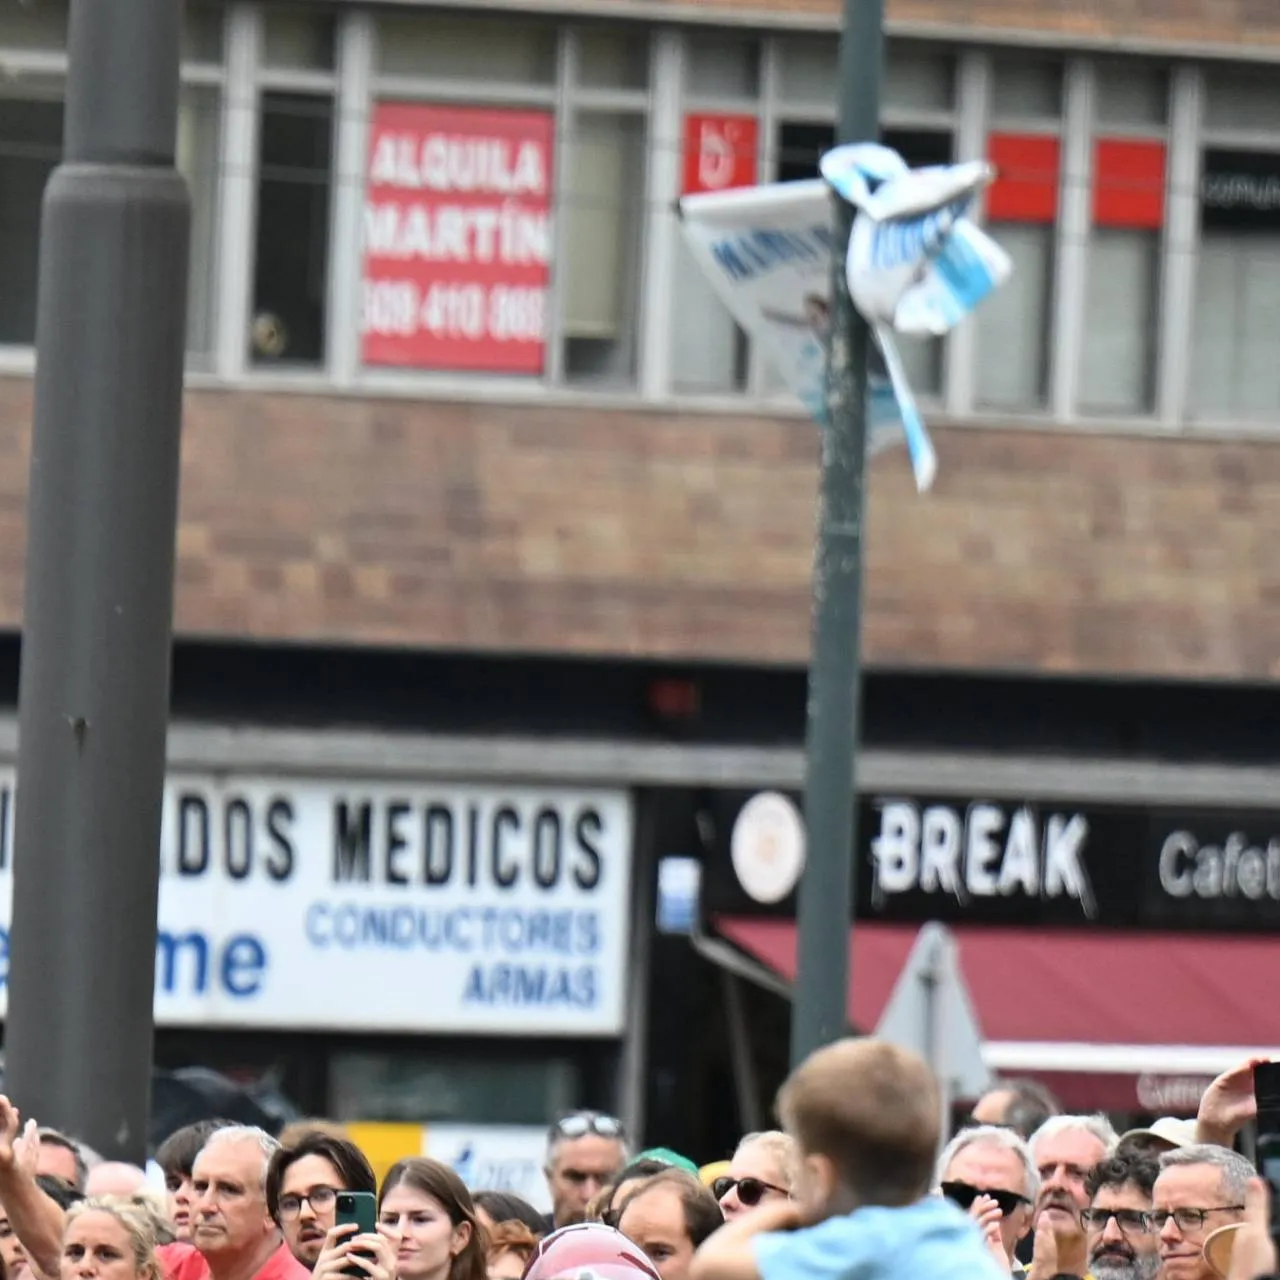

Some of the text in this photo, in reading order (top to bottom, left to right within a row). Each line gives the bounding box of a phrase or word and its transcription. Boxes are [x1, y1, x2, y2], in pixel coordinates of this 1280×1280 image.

[371, 133, 544, 192] ALQUILA
[364, 197, 550, 266] MARTÍN
[335, 800, 605, 891] MEDICOS
[874, 800, 1096, 905] BREAK
[303, 902, 599, 954] CONDUCTORES
[461, 965, 598, 1008] ARMAS
